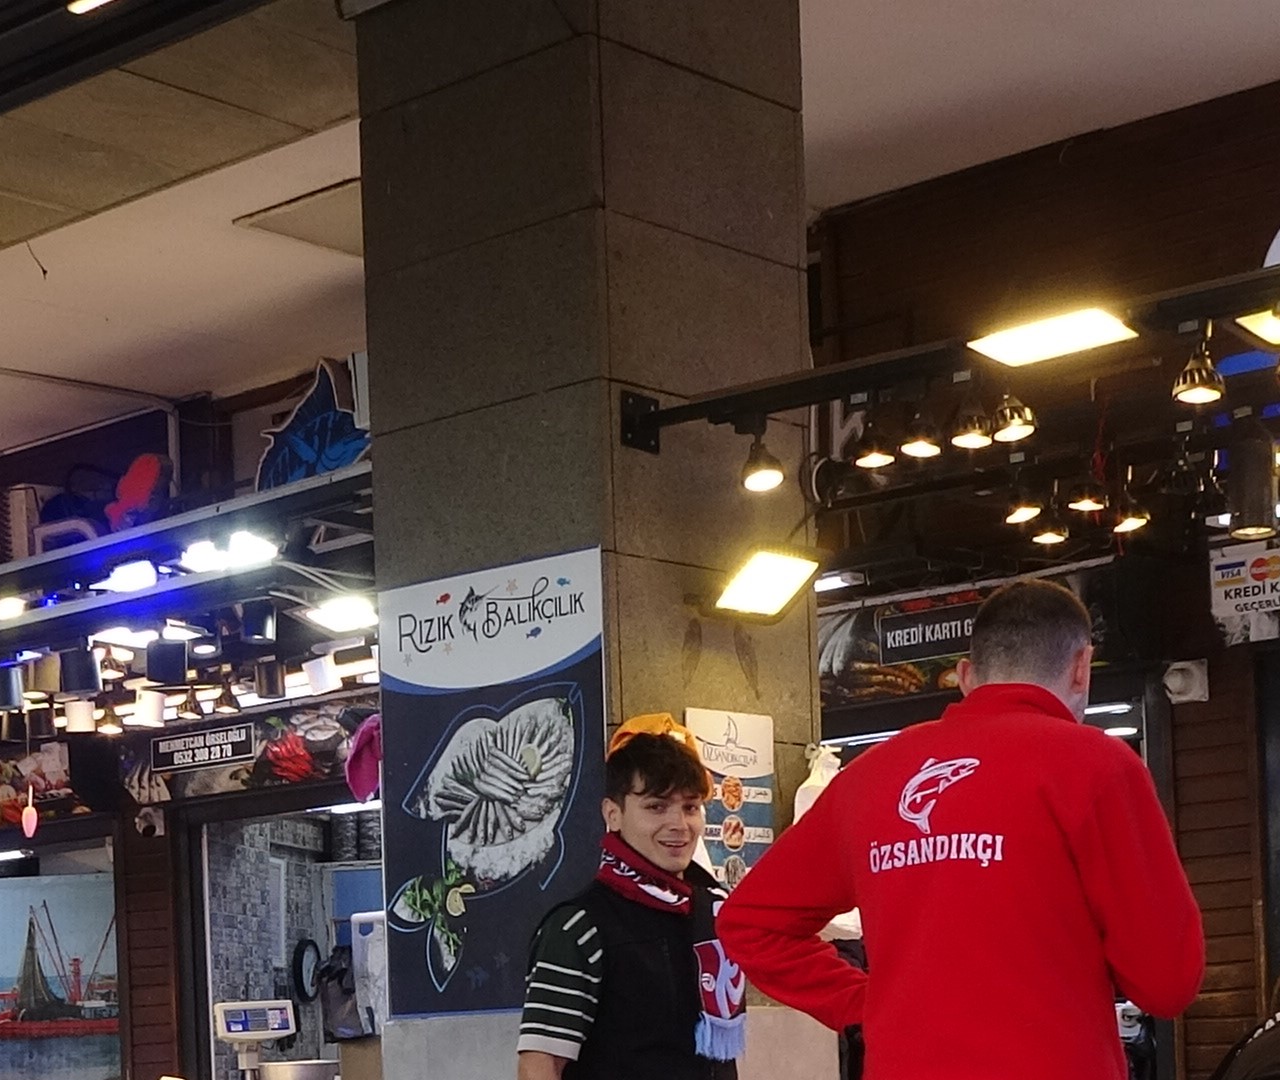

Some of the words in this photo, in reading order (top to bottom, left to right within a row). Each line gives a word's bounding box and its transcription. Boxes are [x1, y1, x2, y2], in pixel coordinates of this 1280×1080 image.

[1224, 581, 1266, 600] KREDİ
[398, 613, 455, 653] RIZIK
[483, 577, 586, 639] BALIKÇILIK
[886, 624, 923, 649] KREDİ
[925, 619, 962, 642] KARTI
[870, 834, 1003, 873] ÖZSANDIKÇI
